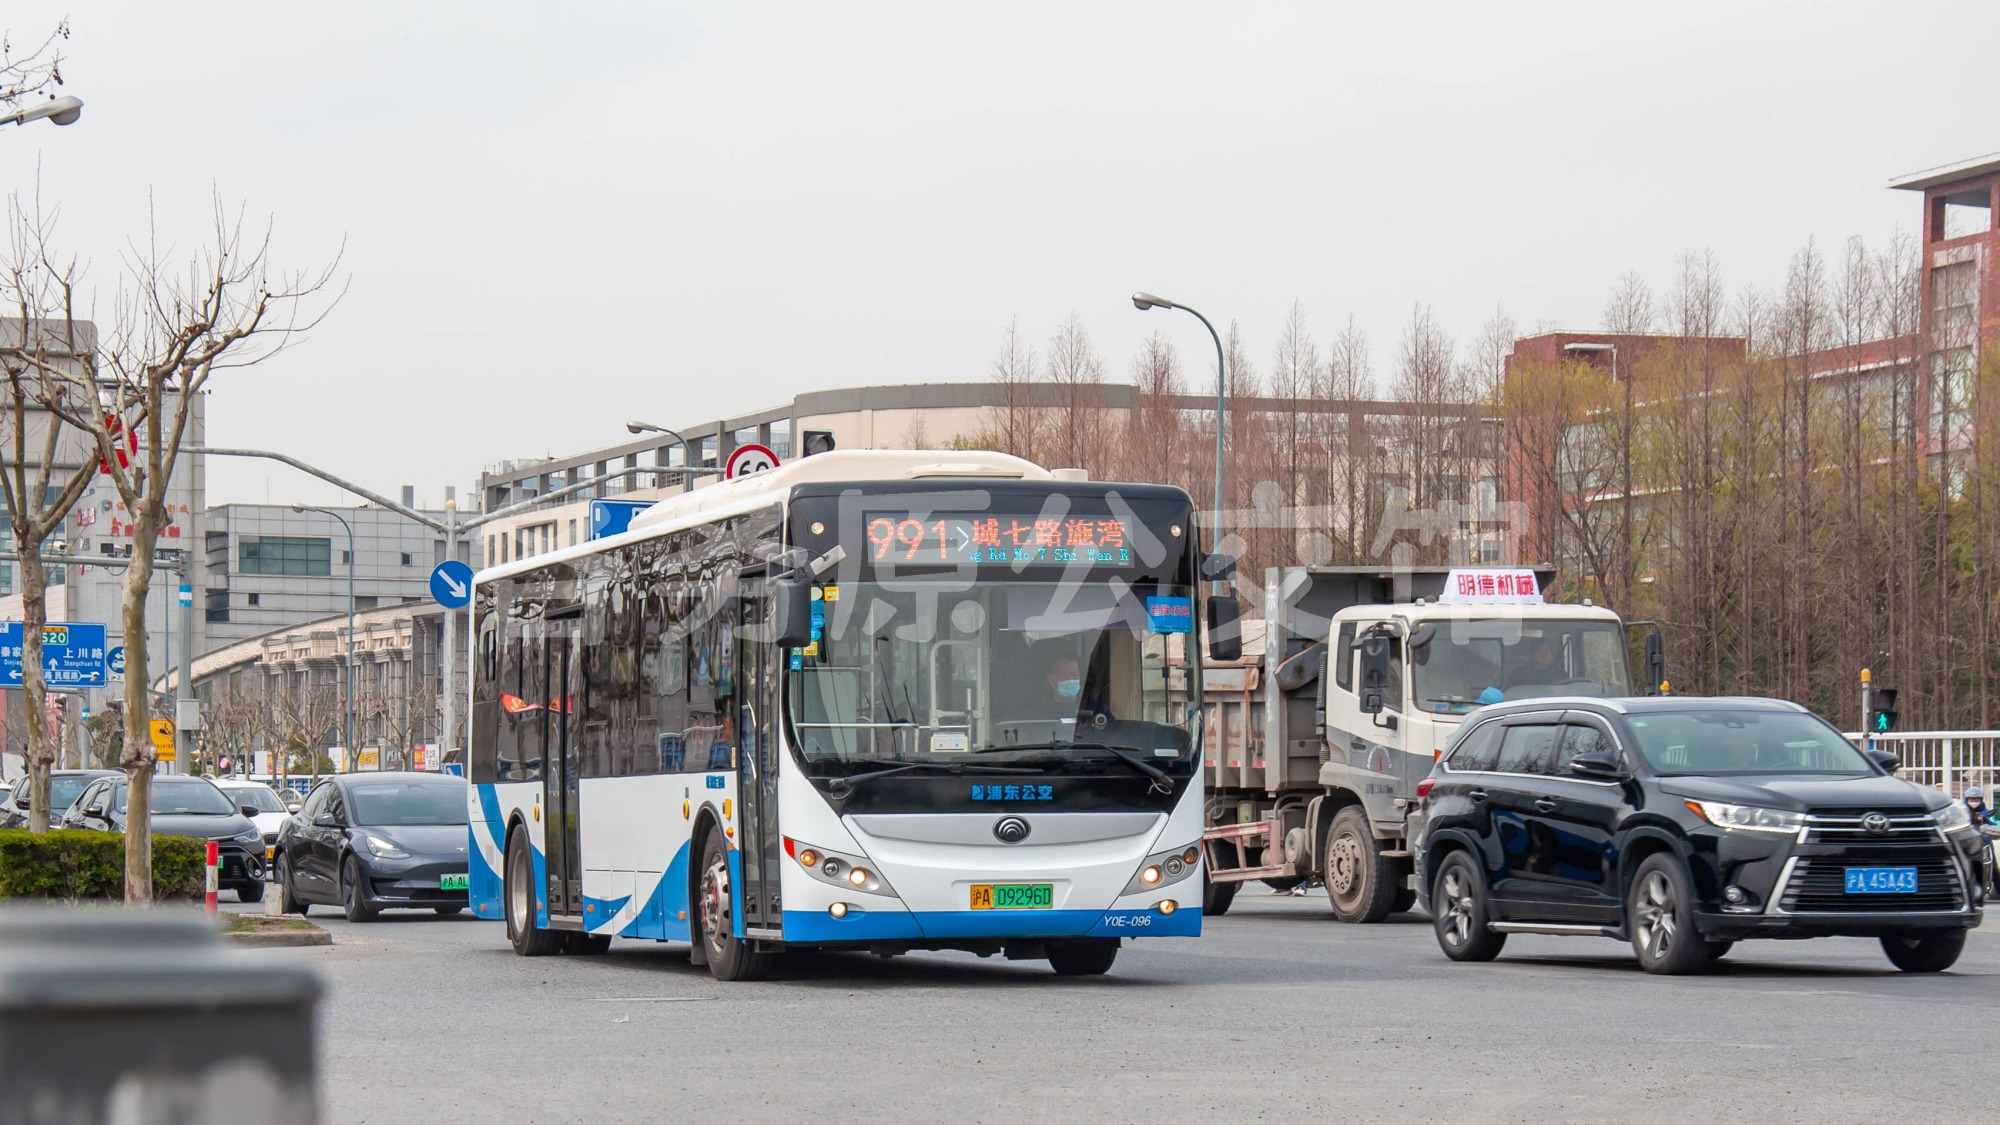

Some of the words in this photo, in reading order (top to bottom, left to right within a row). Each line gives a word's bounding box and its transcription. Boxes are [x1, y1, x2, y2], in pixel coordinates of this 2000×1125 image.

[867, 518, 947, 560] 991
[971, 518, 1126, 547] 城七路施湾
[988, 548, 1007, 561] Rd
[1054, 548, 1078, 561] Shi
[1087, 548, 1113, 561] Wan
[1457, 574, 1535, 596] 明德机械
[42, 632, 66, 643] S20
[63, 647, 103, 659] 上川路
[987, 785, 1053, 800] 浦东公交
